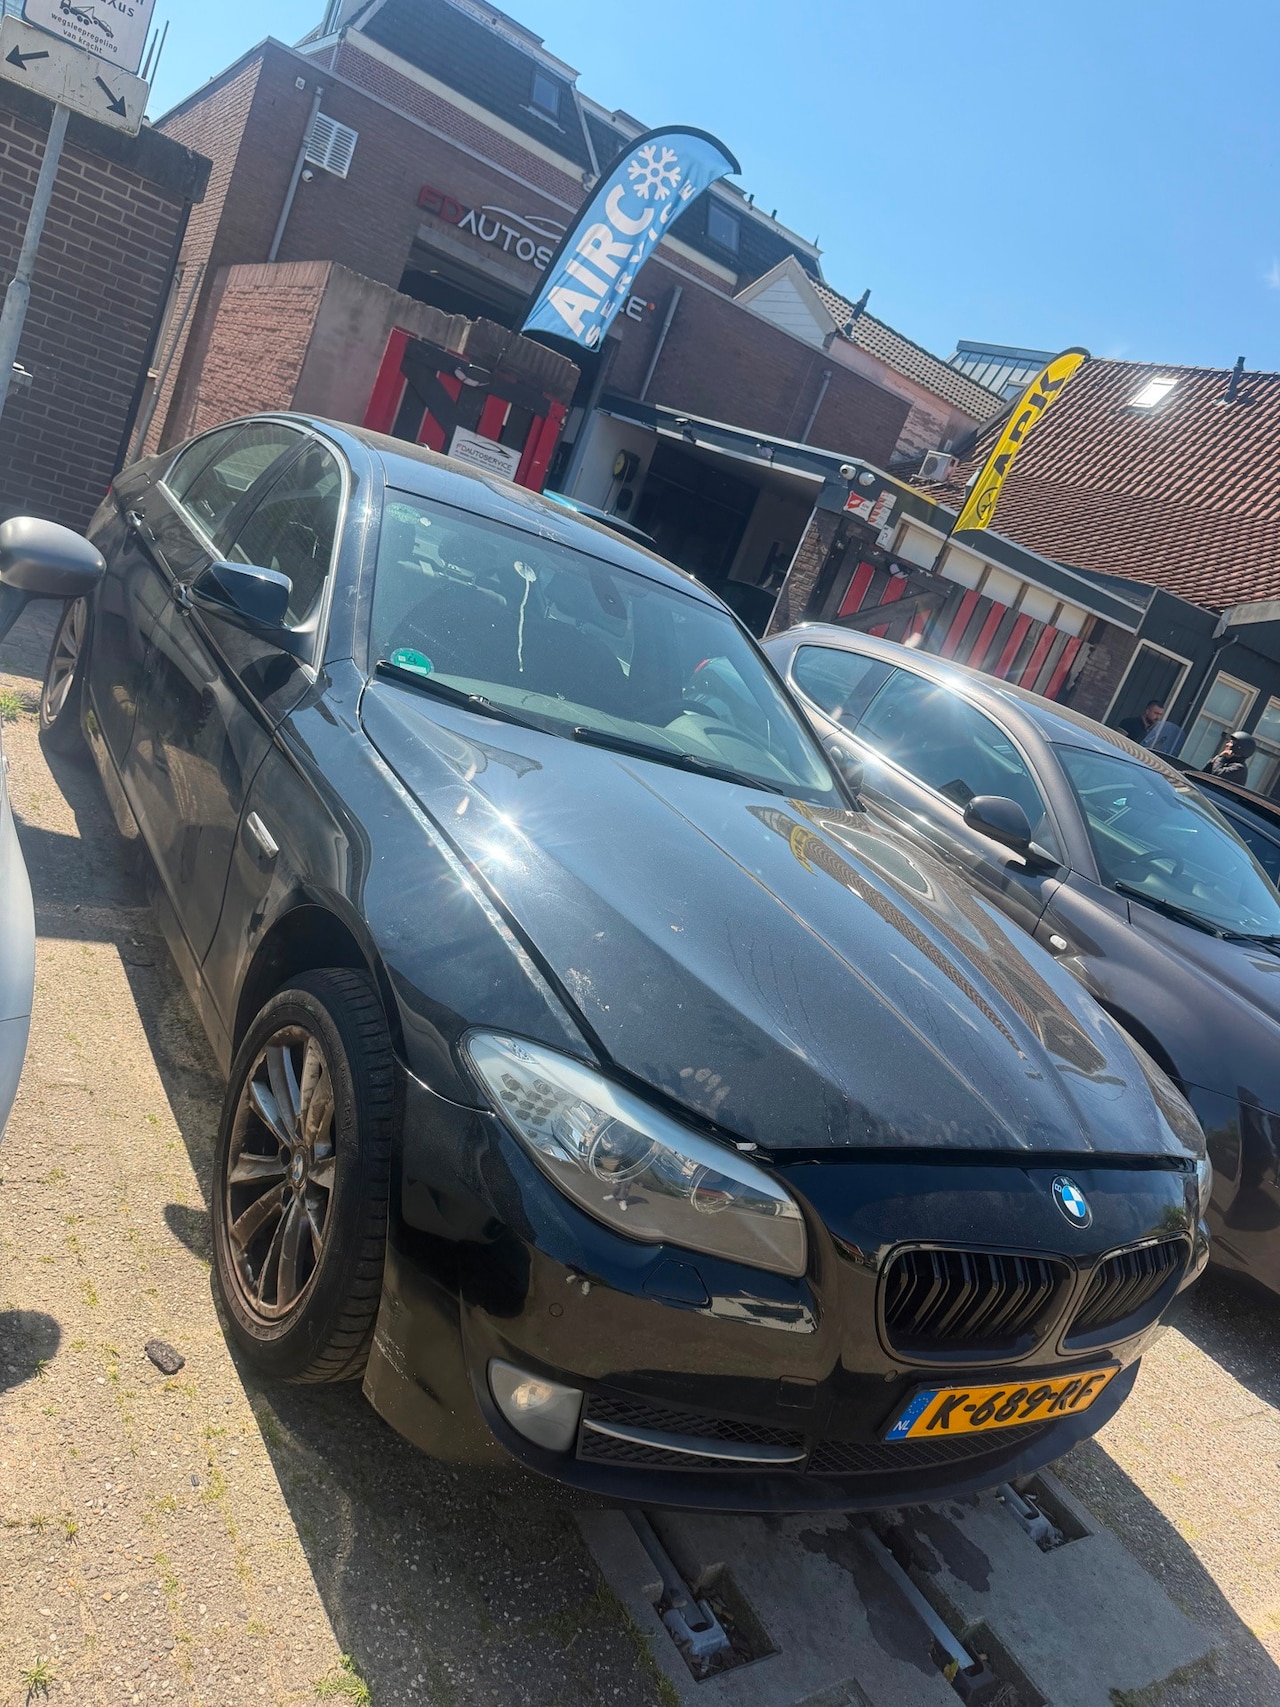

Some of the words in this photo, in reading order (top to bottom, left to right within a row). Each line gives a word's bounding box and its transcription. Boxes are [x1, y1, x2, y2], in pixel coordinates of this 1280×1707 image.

[51, 12, 118, 53] wegsleepregeling
[63, 29, 77, 41] van
[78, 37, 103, 54] kracht
[993, 370, 1066, 479] APK
[892, 1420, 910, 1431] NL
[926, 1373, 1106, 1431] K-689-RF
